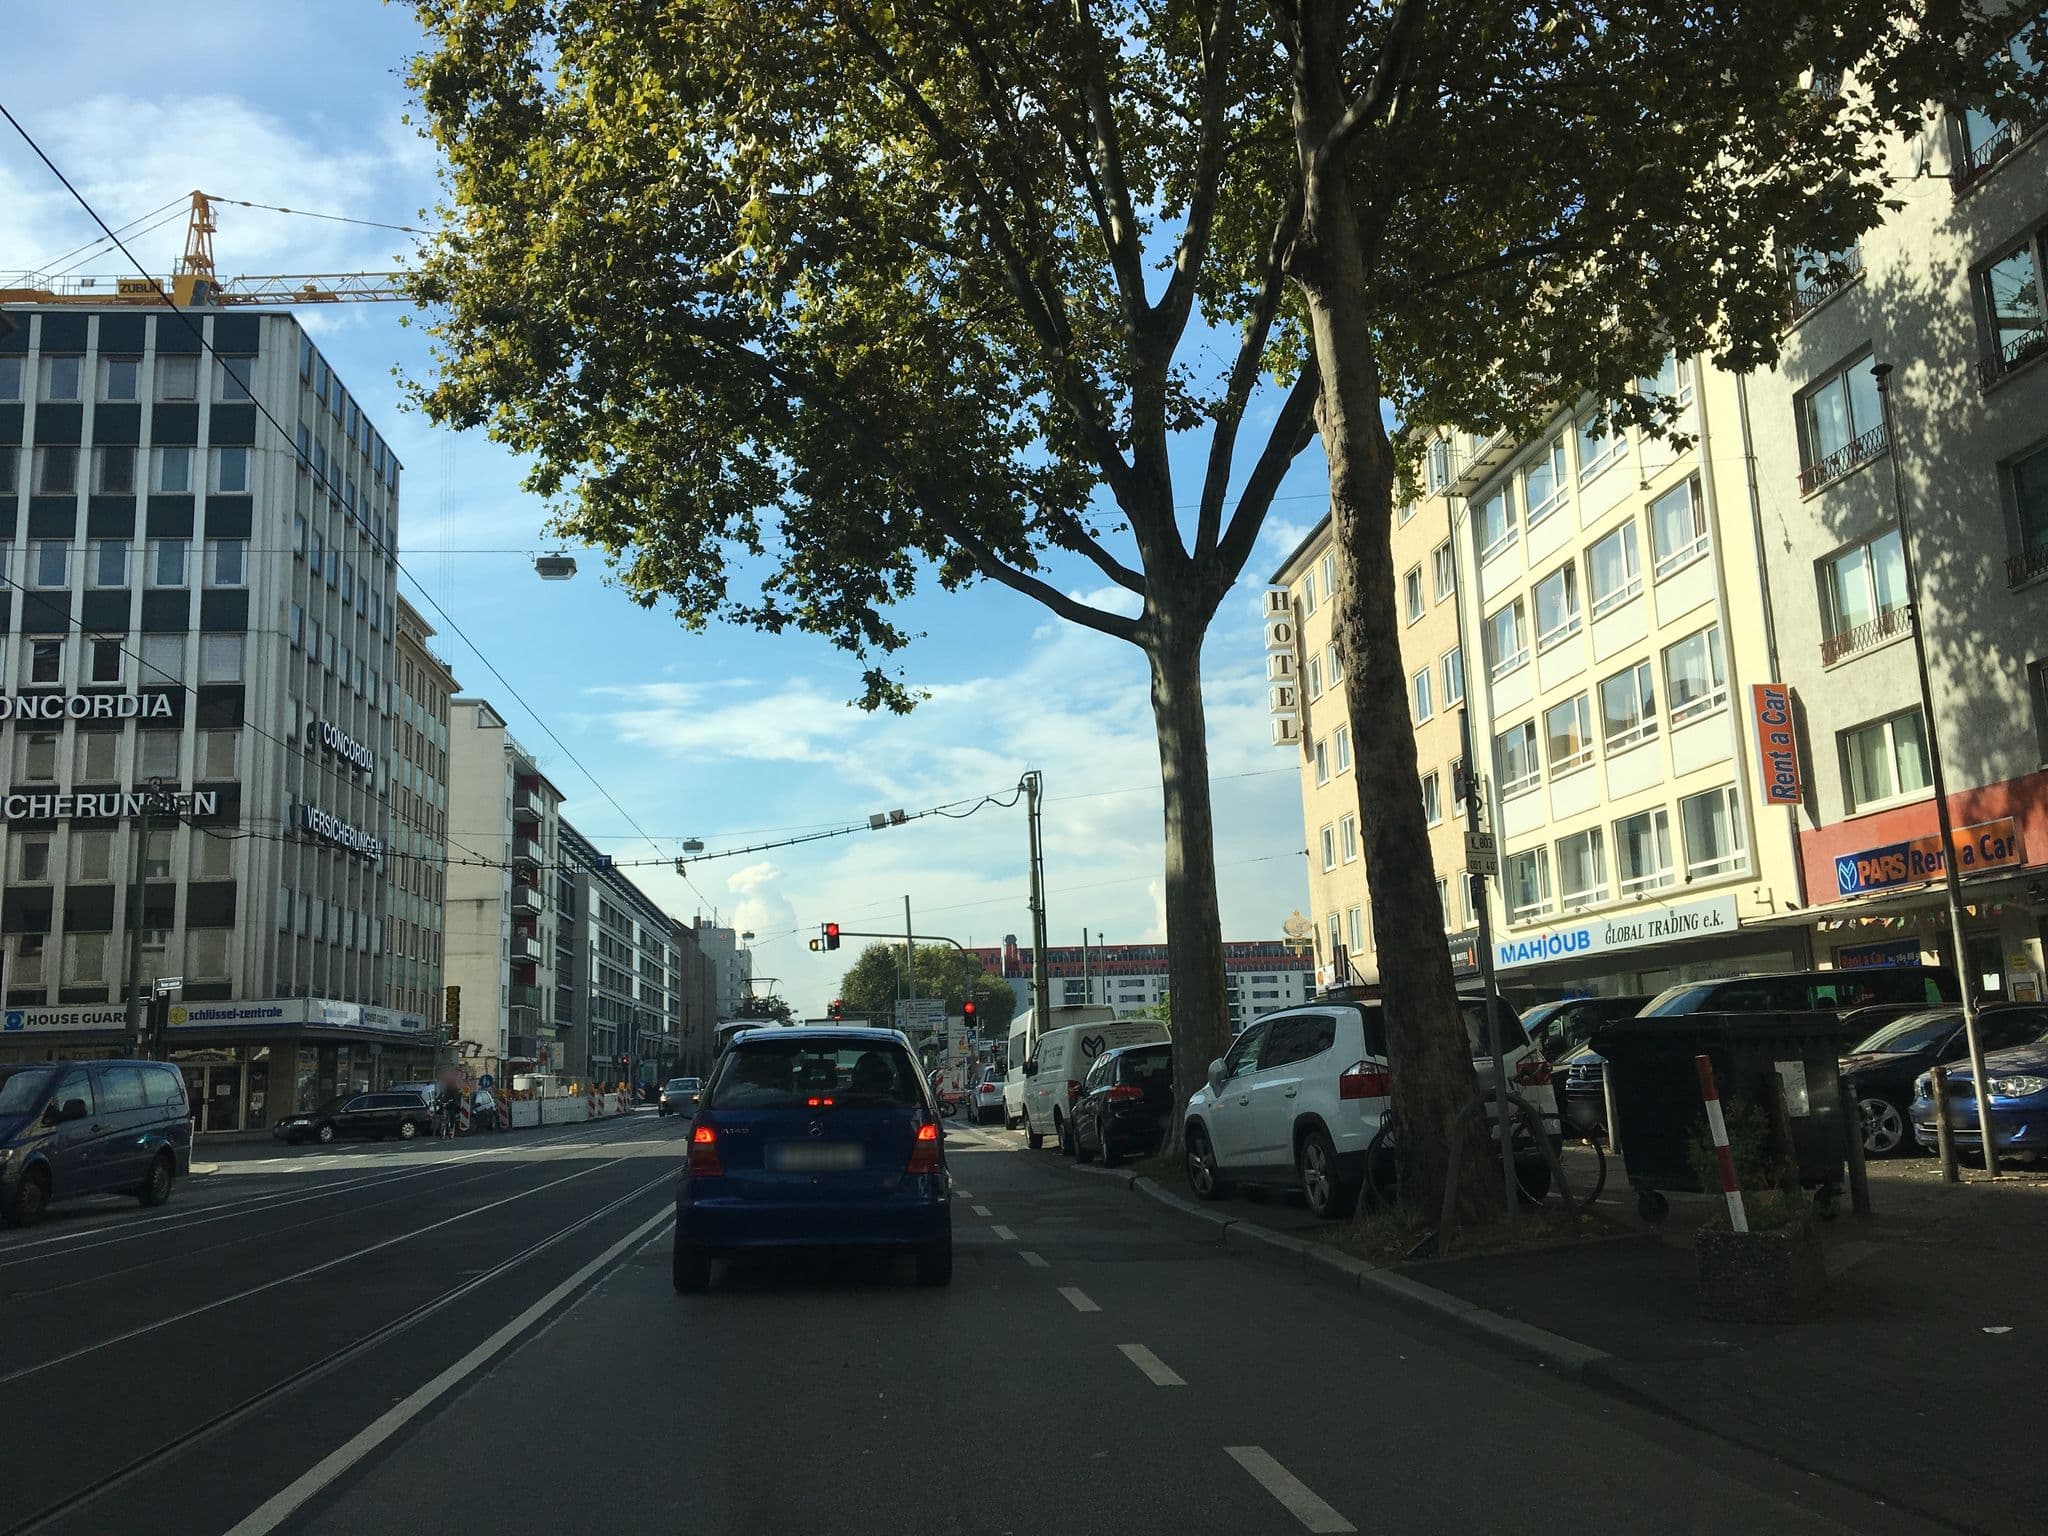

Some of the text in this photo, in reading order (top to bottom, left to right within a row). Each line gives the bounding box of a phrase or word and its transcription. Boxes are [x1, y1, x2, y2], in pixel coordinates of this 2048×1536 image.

[1270, 591, 1298, 740] HOTEL
[323, 722, 375, 774] CONCORDIA
[1761, 688, 1798, 800] Rent a Car
[306, 804, 384, 862] VERSICHERUNGEN
[1857, 833, 2015, 887] PARS Ren a Car
[1605, 923, 1645, 945] GLOBAL
[1648, 913, 1699, 937] TRADING
[1703, 910, 1724, 929] e.k.
[27, 1012, 127, 1026] HOUSE GUAR
[188, 1006, 283, 1021] schlüssel-zentrale
